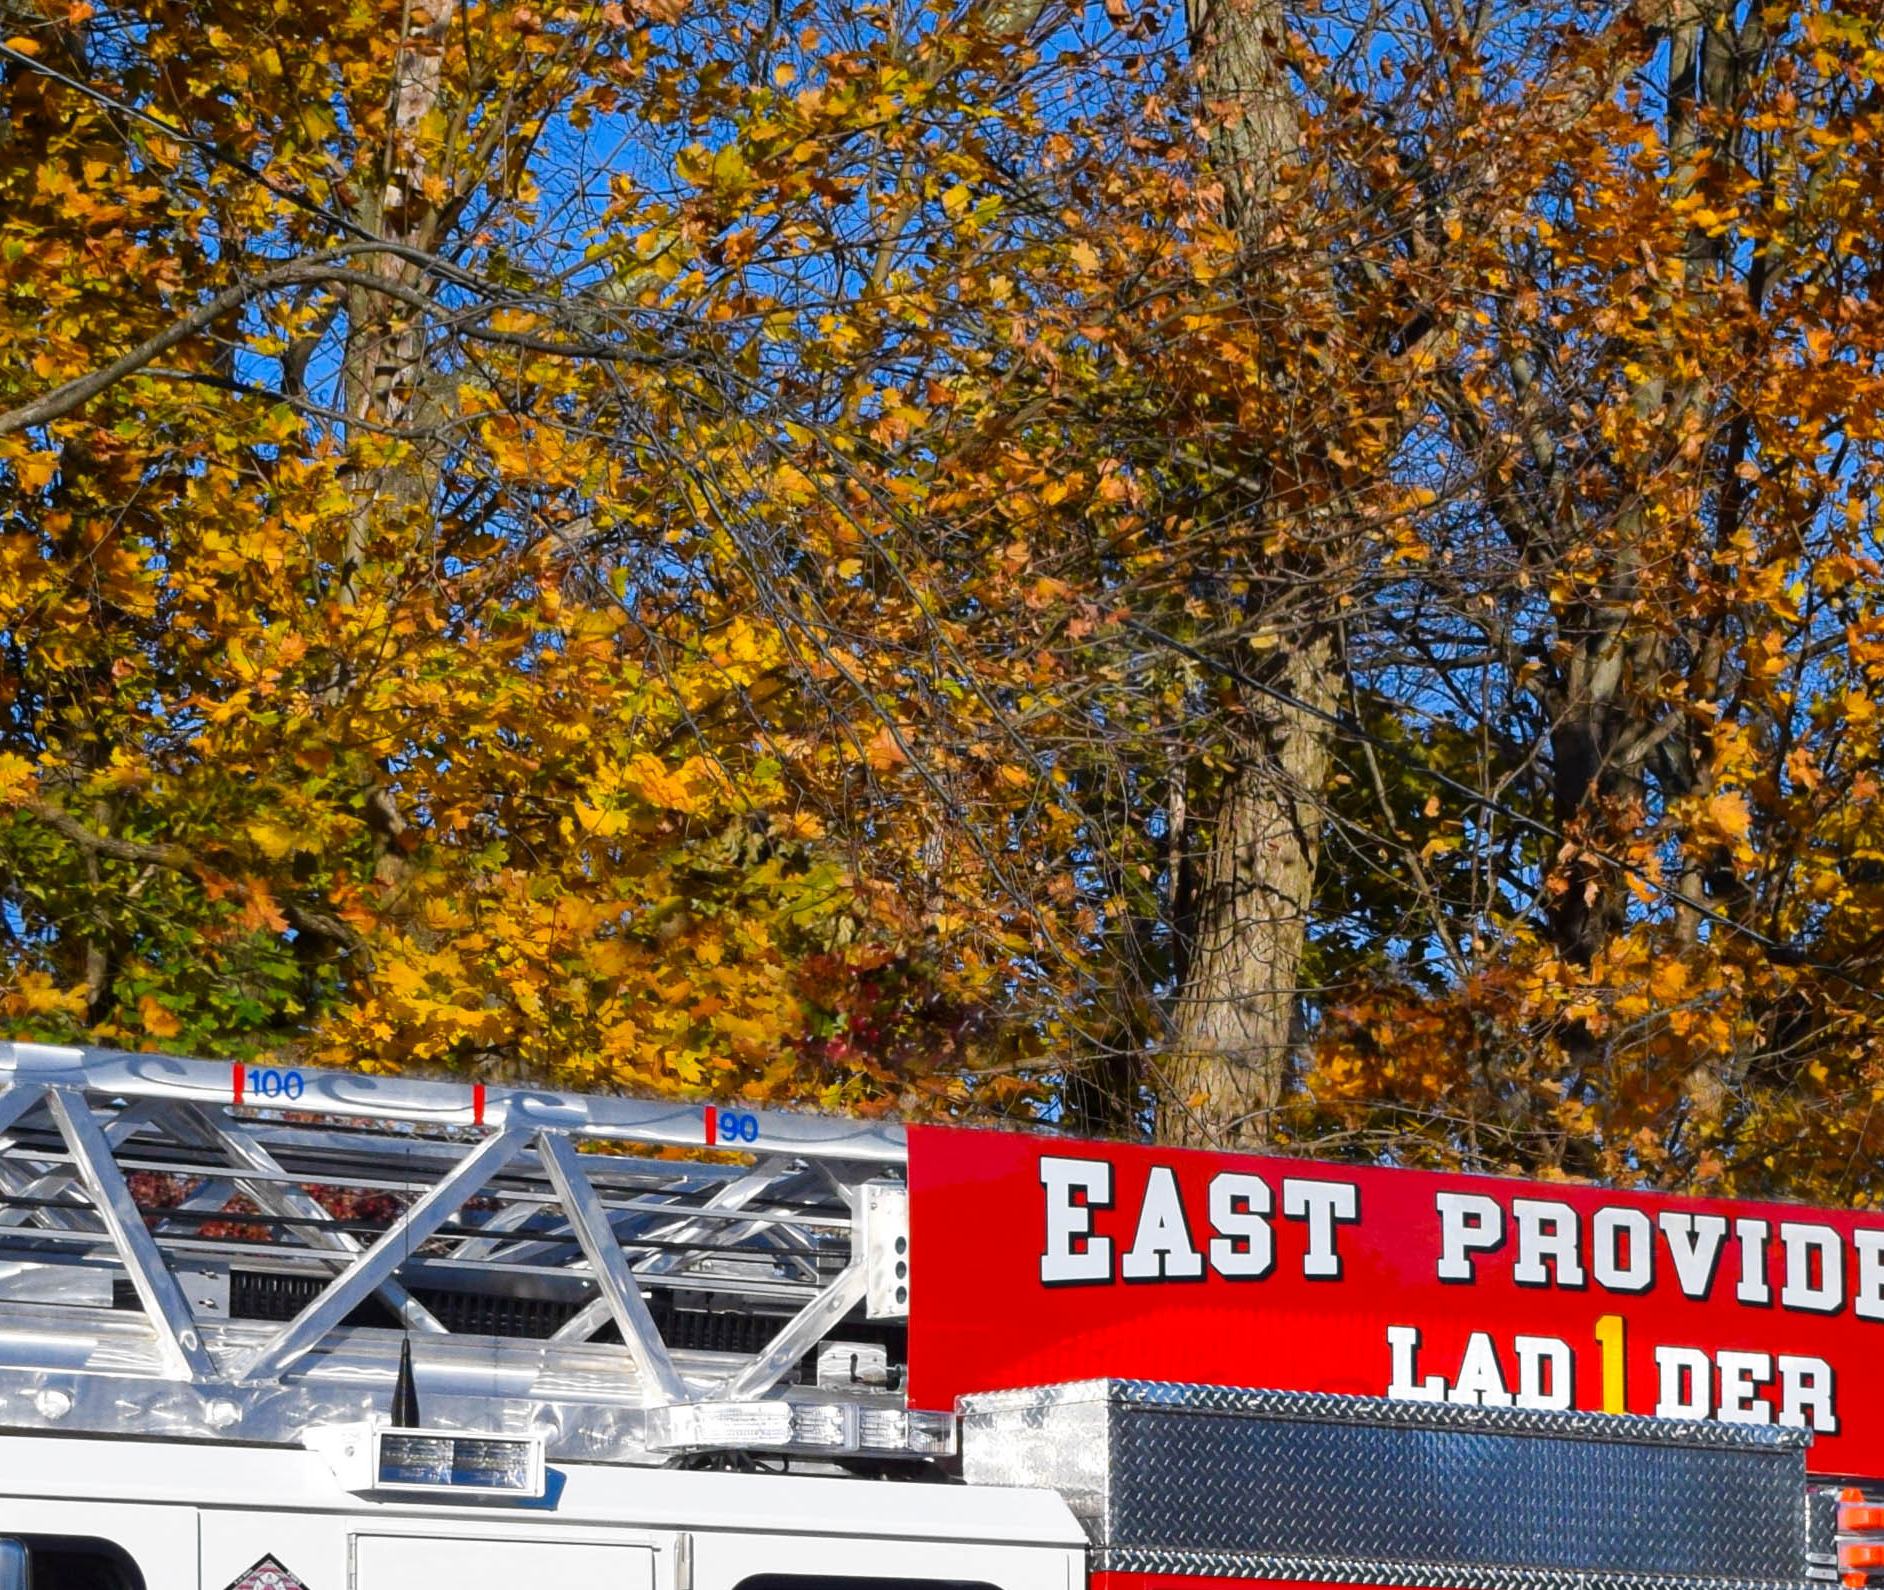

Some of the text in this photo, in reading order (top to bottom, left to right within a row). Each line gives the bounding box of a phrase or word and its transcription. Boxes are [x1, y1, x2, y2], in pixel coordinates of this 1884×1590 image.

[248, 1068, 304, 1101] 100
[720, 1112, 759, 1144] 90
[1039, 1156, 1359, 1287] EAST
